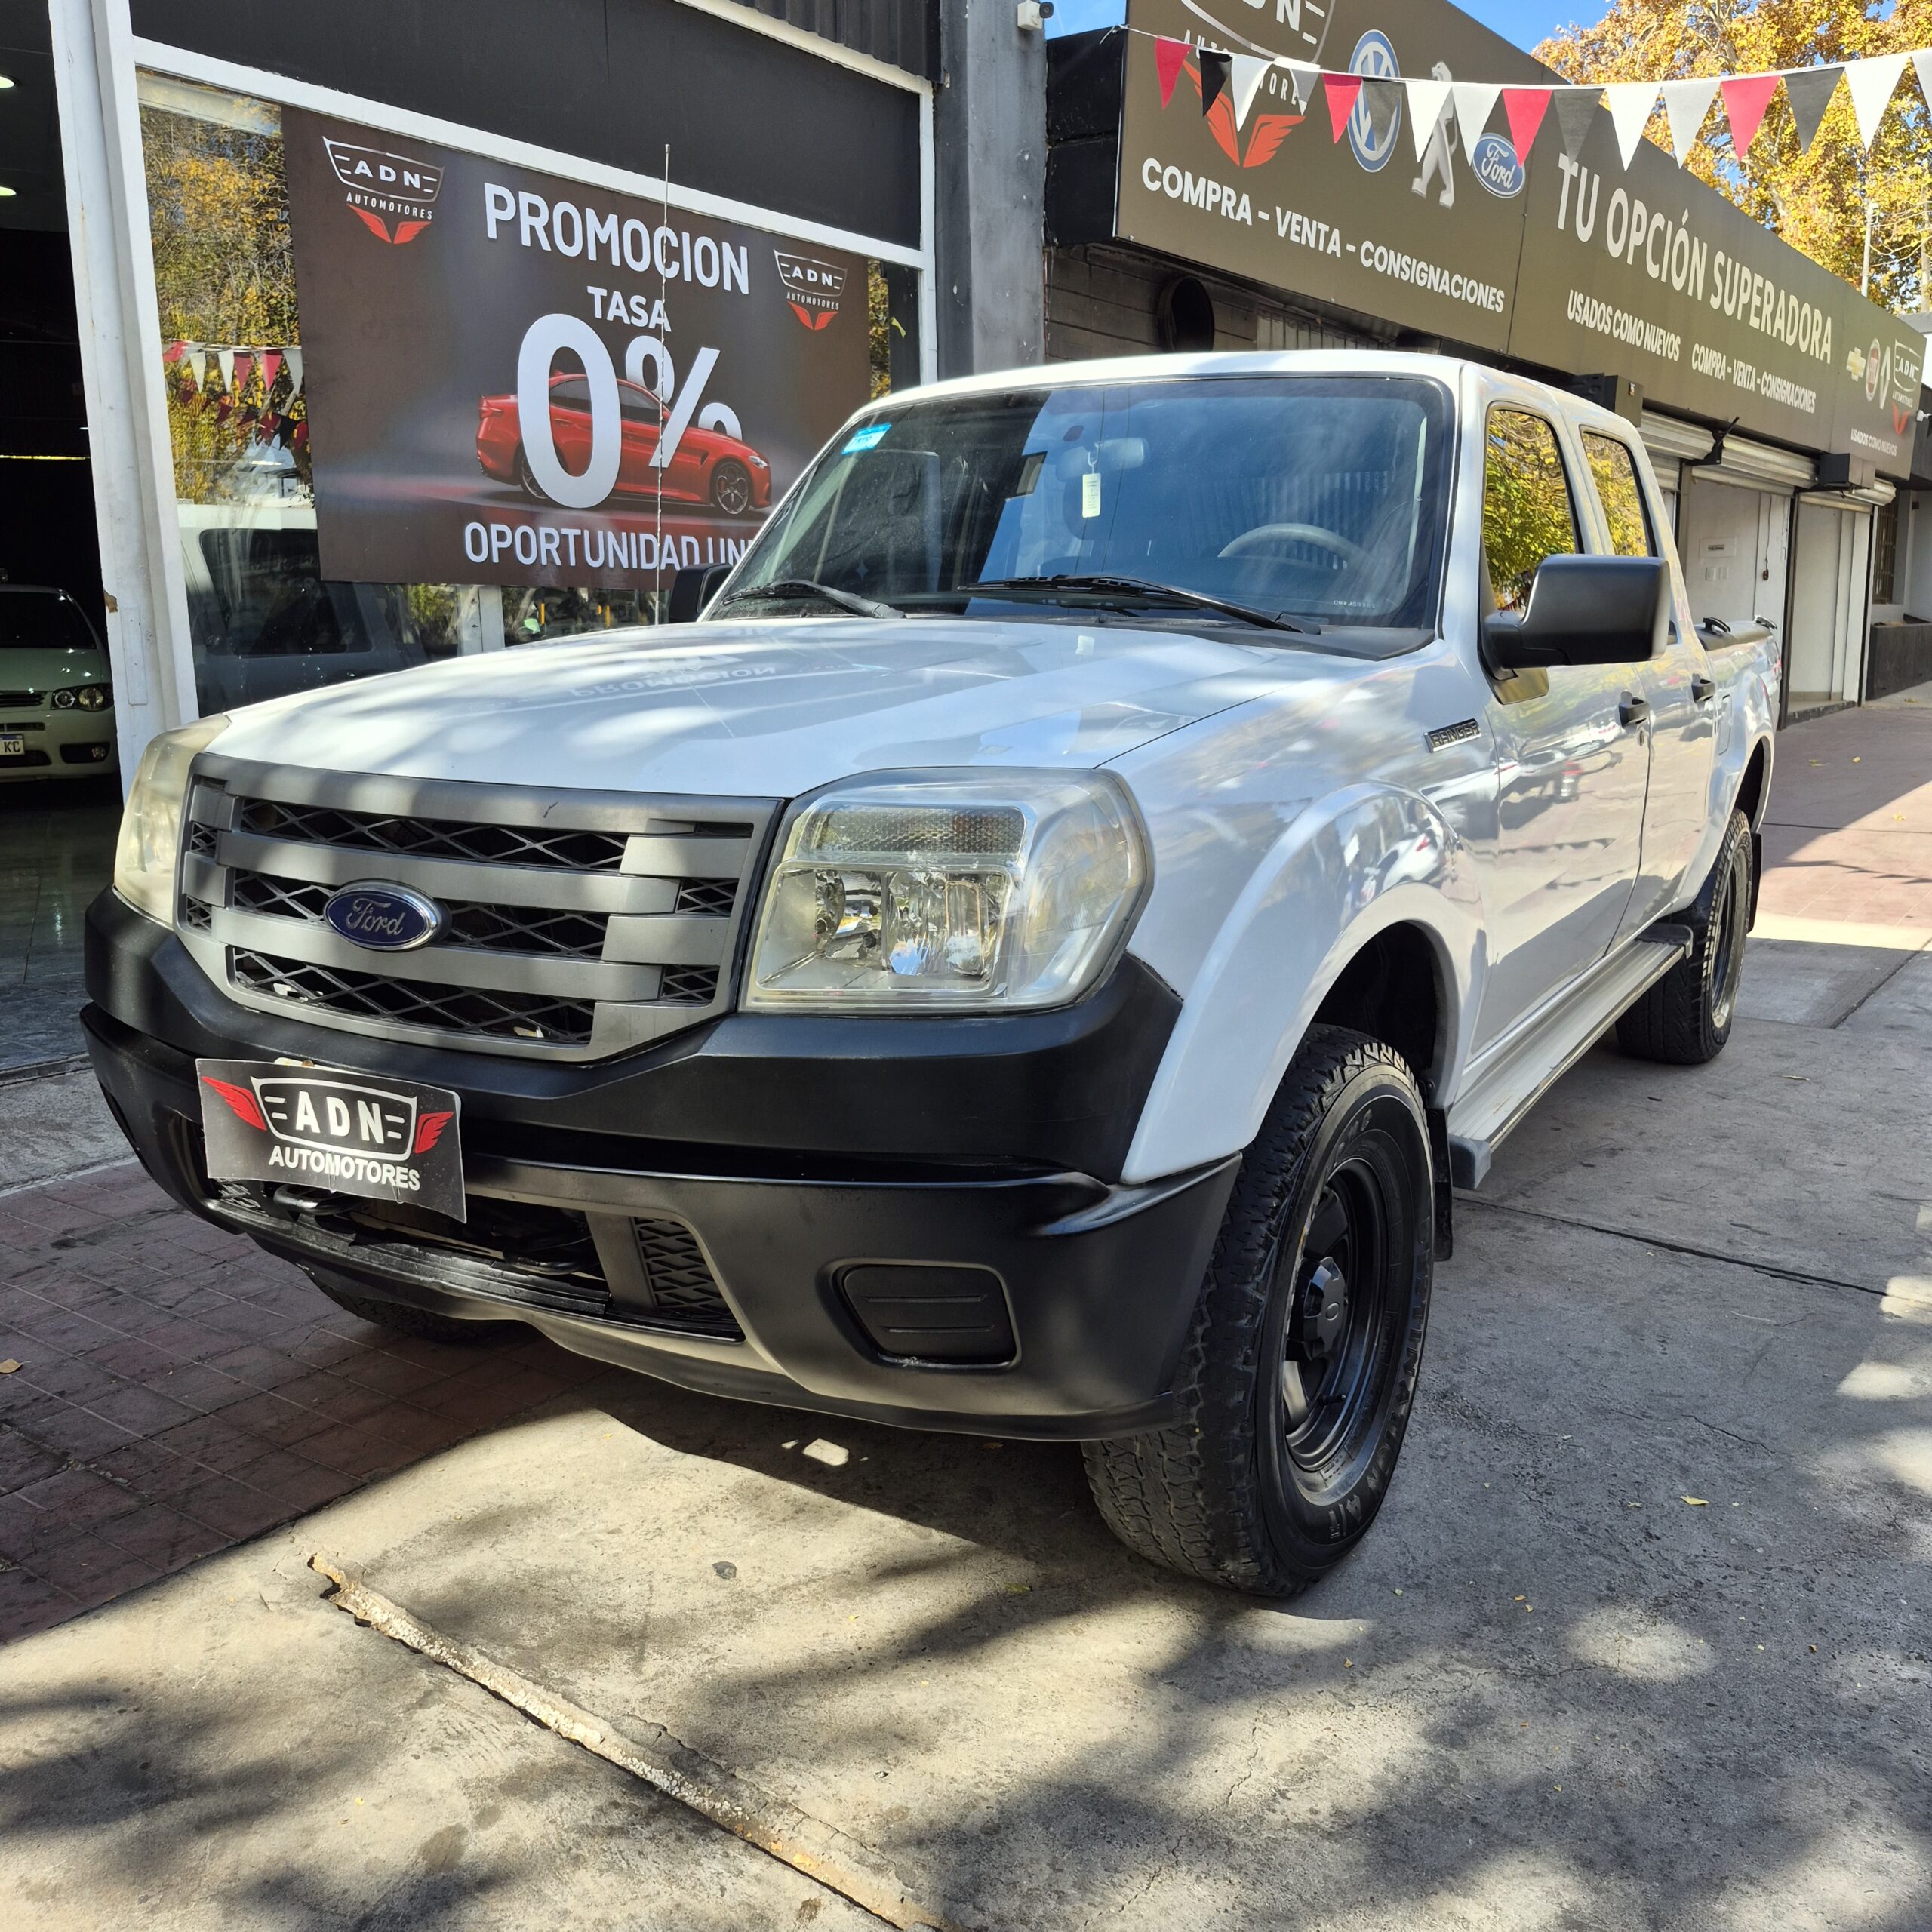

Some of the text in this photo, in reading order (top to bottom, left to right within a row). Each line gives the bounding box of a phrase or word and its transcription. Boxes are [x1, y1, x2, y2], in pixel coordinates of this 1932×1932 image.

[354, 160, 420, 189] ADN
[1481, 142, 1516, 189] Ford
[346, 192, 433, 220] AUTOMOTORES
[484, 182, 750, 295] PROMOCION
[1141, 158, 1253, 226] COMPRA
[1275, 206, 1342, 258] VENTA
[1359, 241, 1506, 313] CONSIGNACIONES
[1558, 153, 1832, 364] TU OPCIÓN SUPERADORA
[792, 266, 833, 287] ADN
[586, 285, 672, 333] TASA
[786, 291, 840, 310] AUTOMOTORES
[1567, 290, 1613, 334] USADOS
[1612, 309, 1644, 348] COMO
[1643, 322, 1681, 361] NUEVOS
[1691, 343, 1726, 380] COMPRA
[1732, 359, 1756, 392] VENTA
[1761, 371, 1817, 414] CONSIGNACIONES
[1898, 358, 1915, 379] ADN
[517, 313, 743, 509] 0%
[1850, 428, 1897, 456] USADOS COMO NUEVOS
[465, 522, 701, 571] OPORTUNIDAD
[4, 741, 20, 753] KC
[1430, 721, 1480, 747] RANGER
[346, 898, 404, 937] Ford
[295, 1091, 385, 1145] ADN
[268, 1145, 421, 1191] AUTOMOTORES
